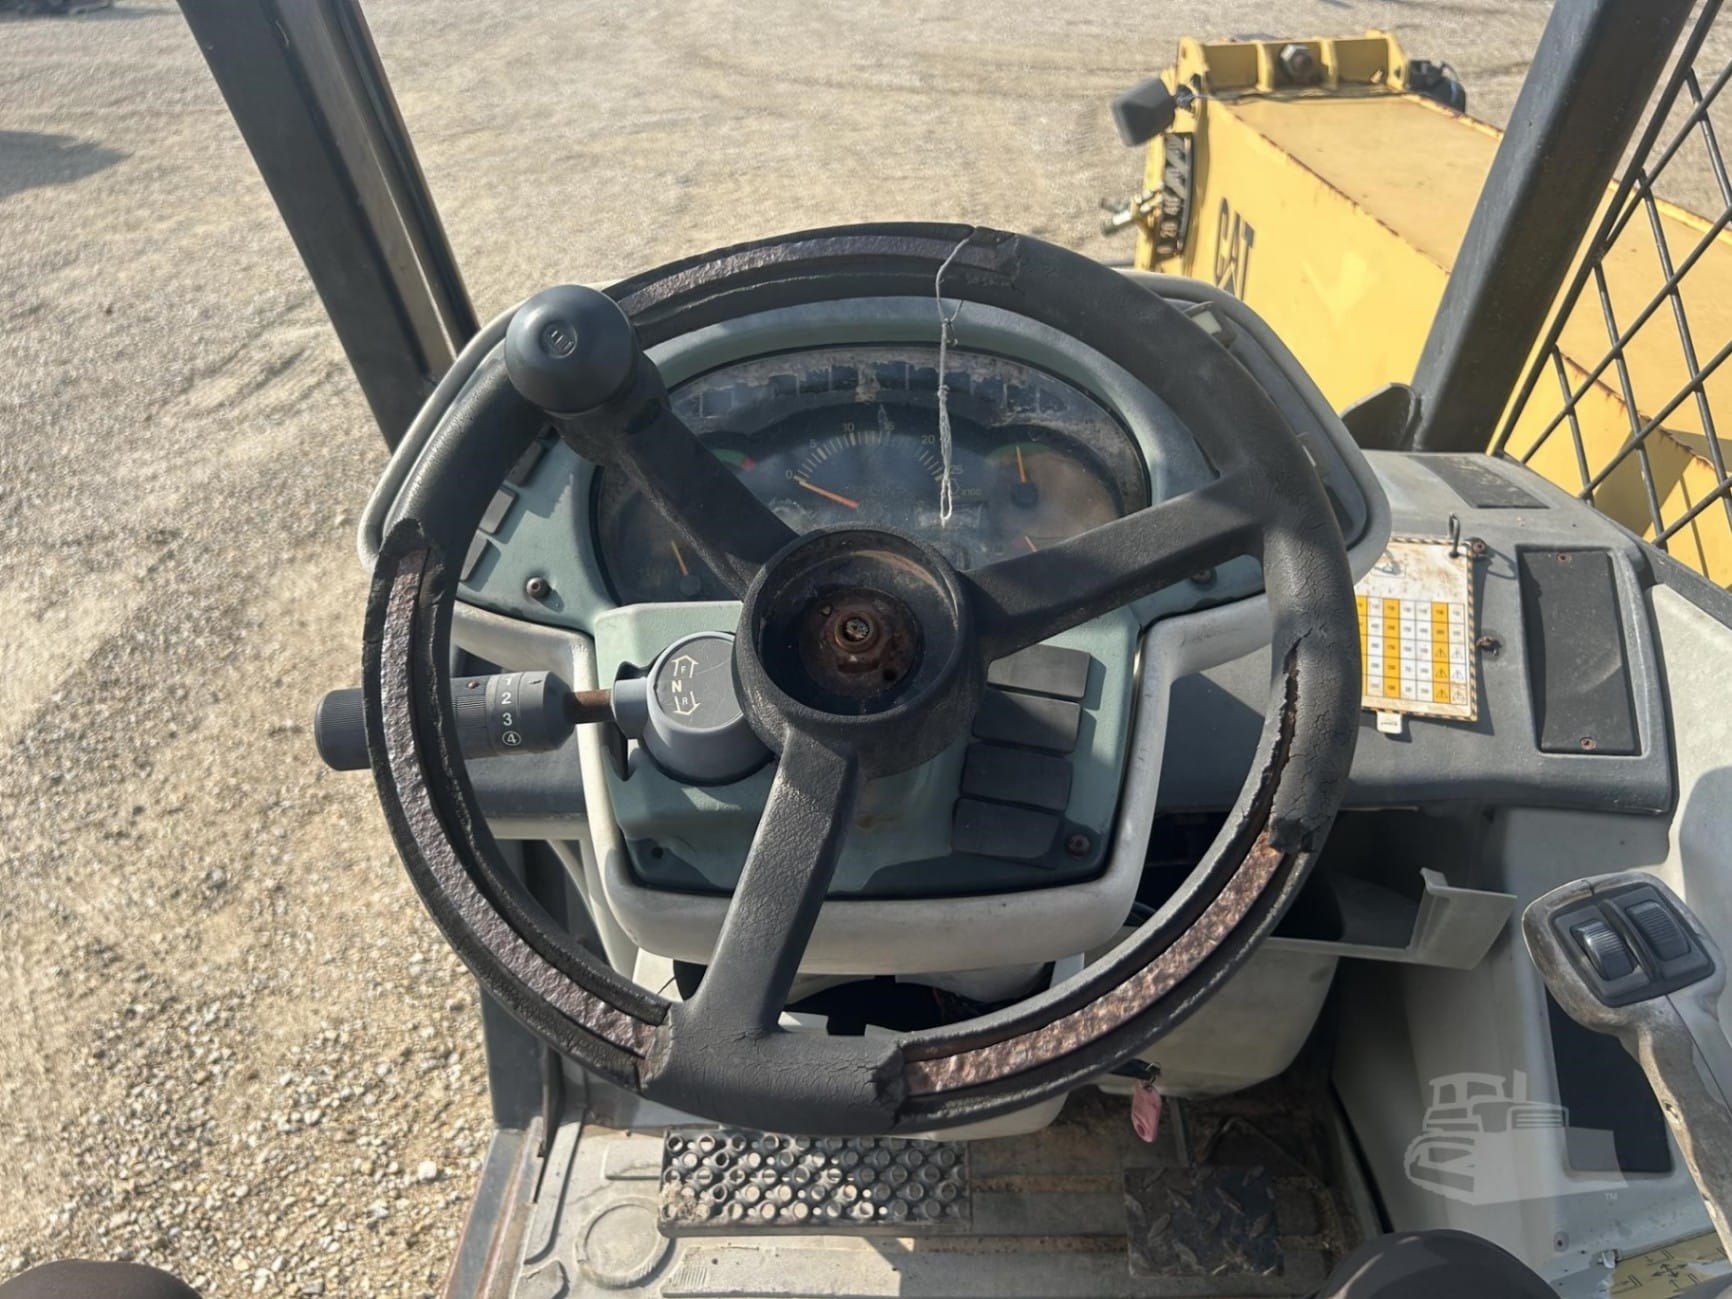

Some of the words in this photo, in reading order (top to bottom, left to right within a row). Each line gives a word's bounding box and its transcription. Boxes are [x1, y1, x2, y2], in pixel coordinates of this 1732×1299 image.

[1215, 196, 1255, 300] CAT
[843, 422, 855, 432] 10
[921, 434, 935, 444] 20
[680, 665, 687, 675] F
[671, 679, 682, 693] N
[501, 691, 512, 705] 2
[681, 696, 689, 705] R
[502, 712, 513, 727] 3
[506, 732, 518, 744] 4
